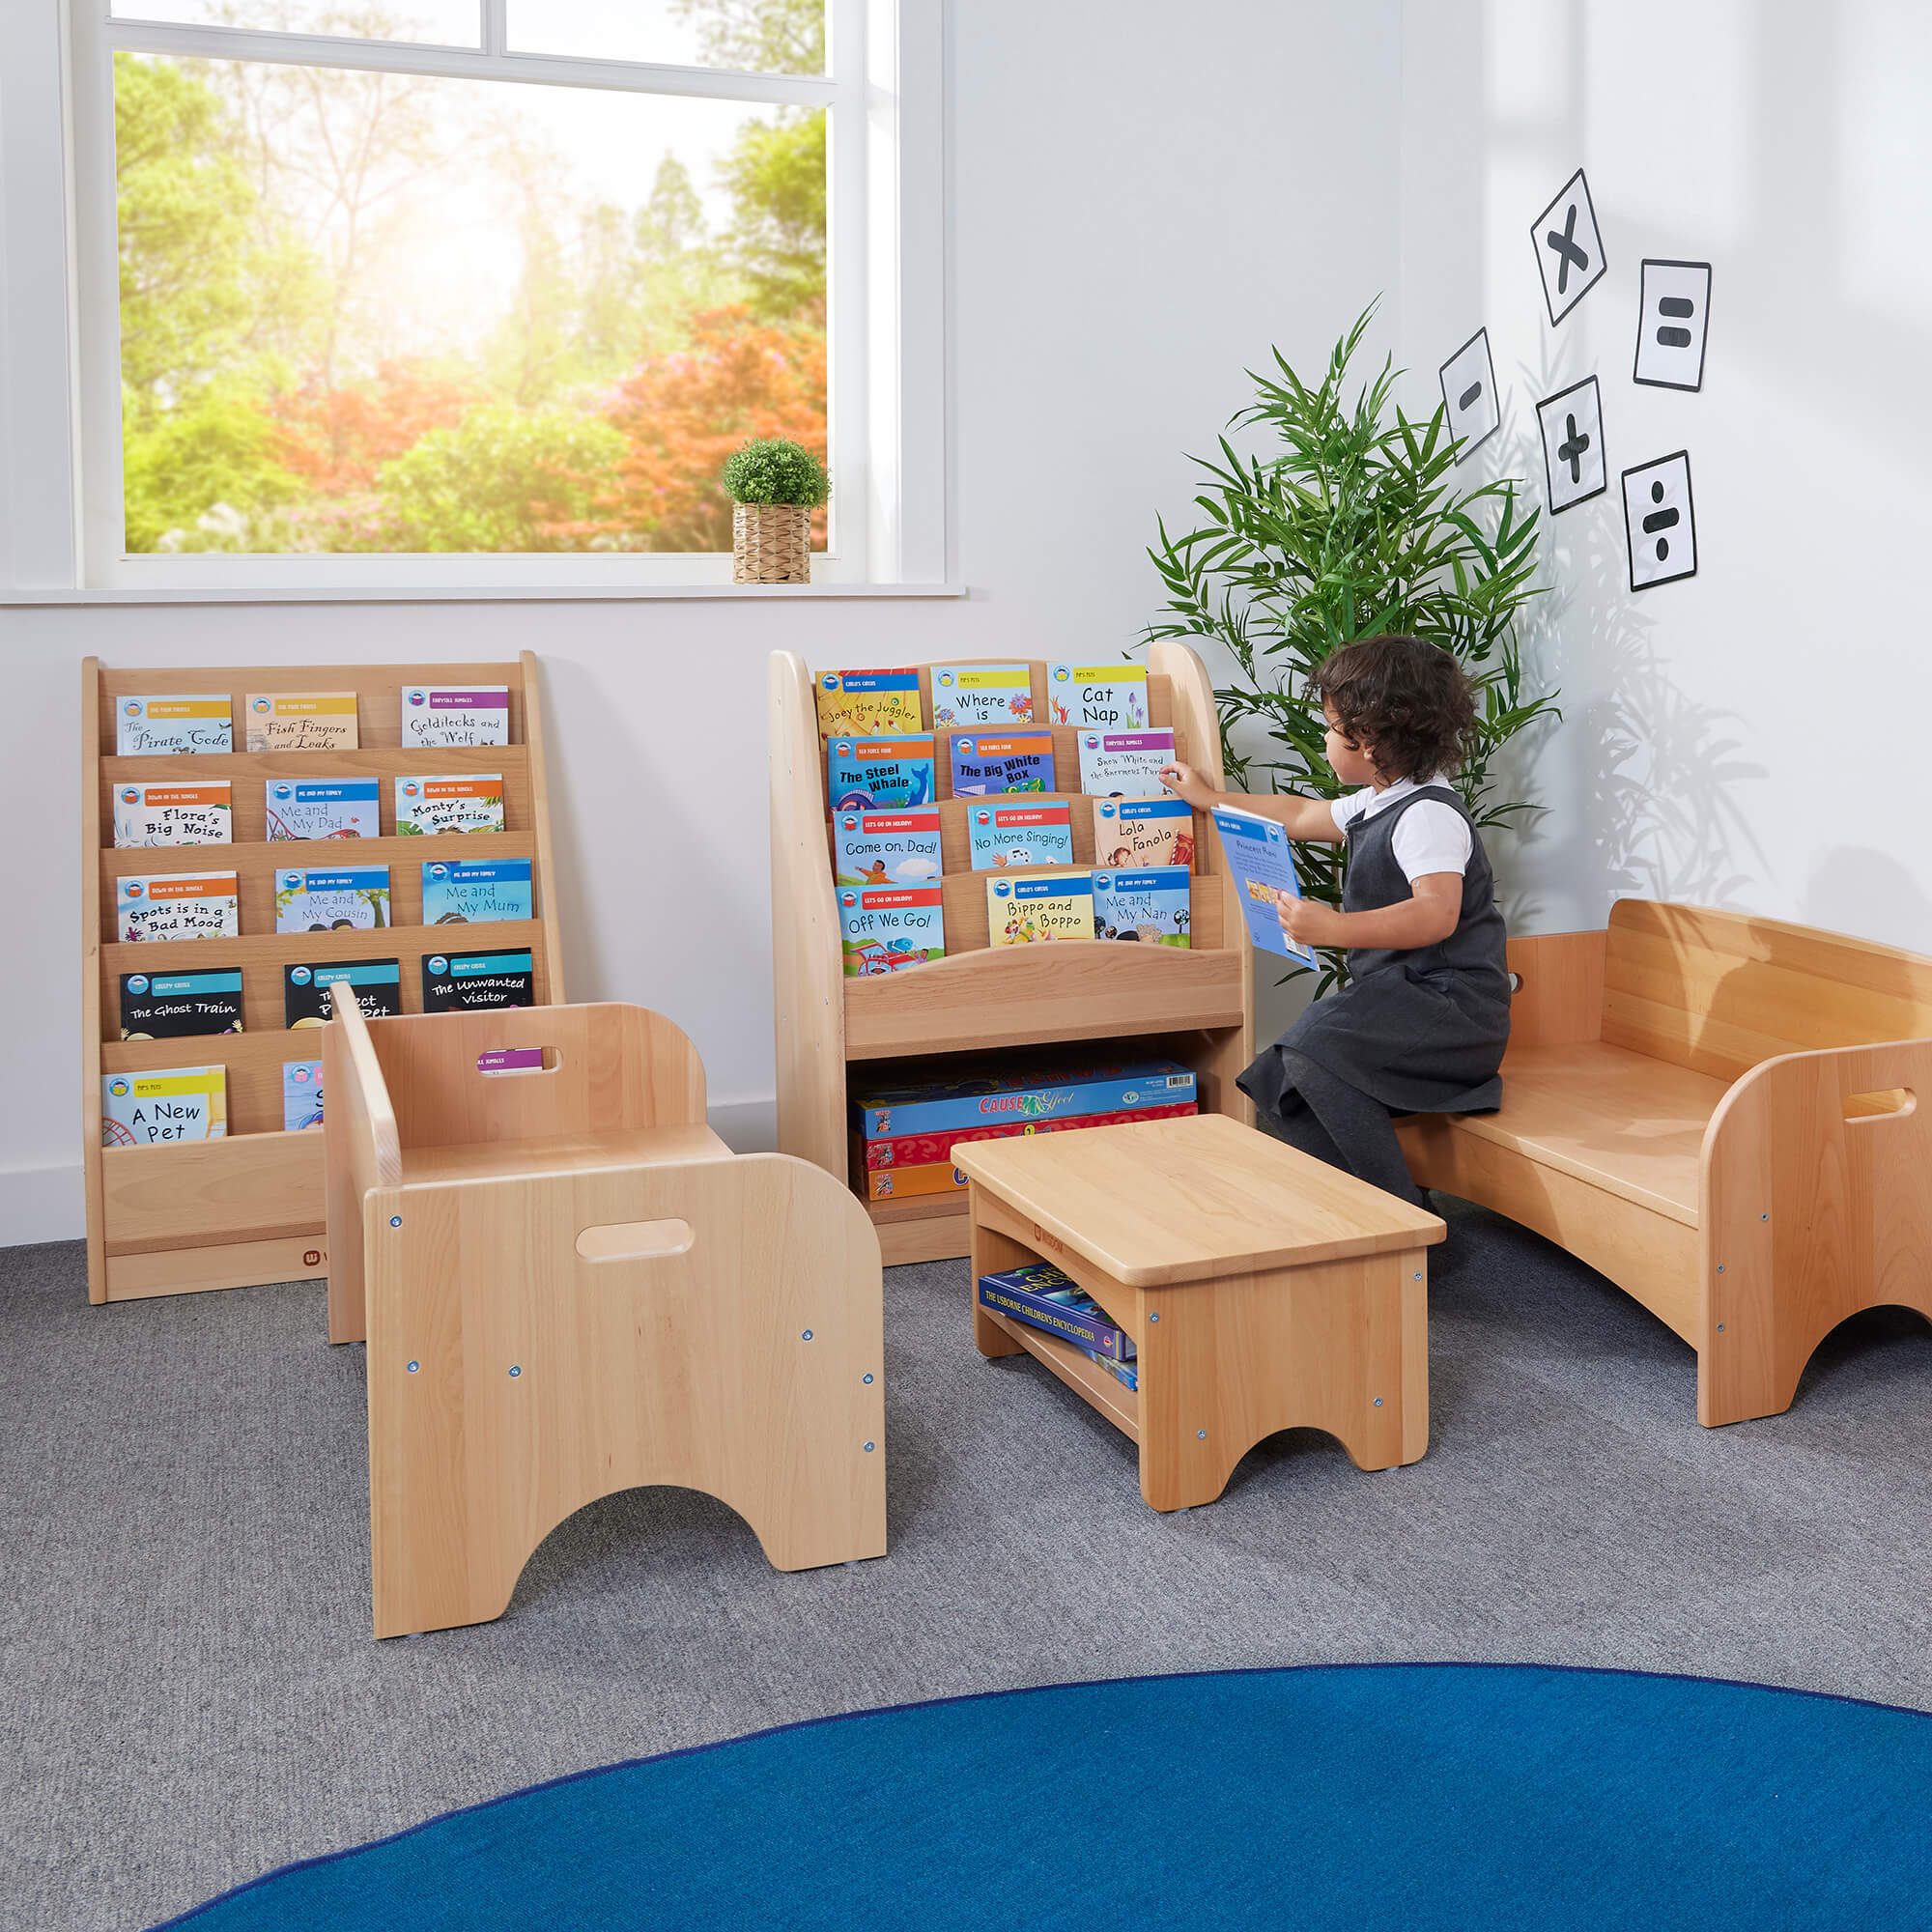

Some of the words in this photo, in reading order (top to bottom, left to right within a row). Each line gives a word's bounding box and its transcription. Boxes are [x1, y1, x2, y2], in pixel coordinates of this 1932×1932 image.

[955, 694, 1006, 708] Where
[1082, 687, 1114, 703] Cat
[829, 708, 853, 723] Joey
[855, 702, 874, 713] the
[877, 701, 917, 721] Juggler
[975, 709, 989, 720] is
[1082, 706, 1119, 725] Nap
[126, 722, 143, 732] The
[265, 721, 297, 735] Fish
[298, 719, 347, 737] Fingers
[411, 714, 475, 735] Goldilocks
[480, 718, 500, 728] and
[132, 729, 183, 750] Pirate
[187, 728, 230, 746] Code
[273, 739, 294, 750] and
[441, 731, 474, 744] Wolf
[959, 764, 981, 777] The
[983, 765, 1004, 777] Big
[1004, 754, 1040, 771] White
[1096, 756, 1118, 766] Snow
[1121, 754, 1148, 764] White
[839, 771, 864, 783] The
[865, 764, 900, 780] Steel
[1006, 770, 1030, 783] Box
[1103, 768, 1140, 777] Enormous
[868, 777, 909, 792] Whale
[161, 808, 220, 826] Flora's
[281, 804, 303, 818] Me
[305, 803, 328, 816] and
[412, 800, 466, 817] Monty's
[293, 818, 316, 832] My
[319, 817, 342, 829] Dad
[431, 810, 491, 826] Surprise
[145, 823, 173, 837] Big
[184, 823, 223, 838] Noise
[1119, 820, 1145, 837] Lola
[845, 842, 882, 856] Come
[907, 838, 937, 854] Dad!
[975, 838, 991, 850] No
[994, 834, 1024, 844] More
[1027, 831, 1068, 849] Singing!
[1132, 828, 1172, 852] Fanola
[309, 893, 329, 906] Me
[331, 892, 354, 905] and
[446, 886, 468, 899] Me
[470, 883, 496, 897] and
[456, 900, 479, 917] My
[487, 898, 520, 913] Mum
[1007, 901, 1044, 918] Bippo
[1048, 898, 1073, 912] and
[1106, 896, 1127, 909] Me
[1129, 893, 1151, 906] and
[128, 903, 172, 923] Spots
[177, 902, 189, 915] is
[193, 902, 209, 915] in
[213, 907, 223, 920] a
[301, 909, 323, 923] My
[325, 906, 369, 921] Cousin
[1118, 909, 1140, 923] My
[1142, 907, 1167, 921] Nan
[148, 918, 179, 932] Bad
[183, 917, 223, 930] Mood
[848, 915, 875, 934] Off
[878, 914, 900, 928] We
[903, 913, 931, 929] Go!
[1039, 915, 1081, 928] Boppo
[432, 984, 454, 996] The
[457, 977, 526, 990] Unwanted
[462, 992, 507, 1005] Visitor
[130, 1008, 152, 1020] The
[155, 1003, 192, 1016] Ghost
[195, 1001, 237, 1014] Train
[360, 1006, 391, 1018] Pet
[132, 1108, 147, 1125] A
[154, 1102, 200, 1121] New
[979, 1096, 1024, 1114] CAUSE
[148, 1124, 185, 1143] Pet
[985, 1290, 996, 1302] THE
[996, 1293, 1022, 1313] USBORNE
[1021, 1302, 1053, 1324] CHILDREN'S
[1053, 1315, 1095, 1342] ENCYCLOPEDIA
